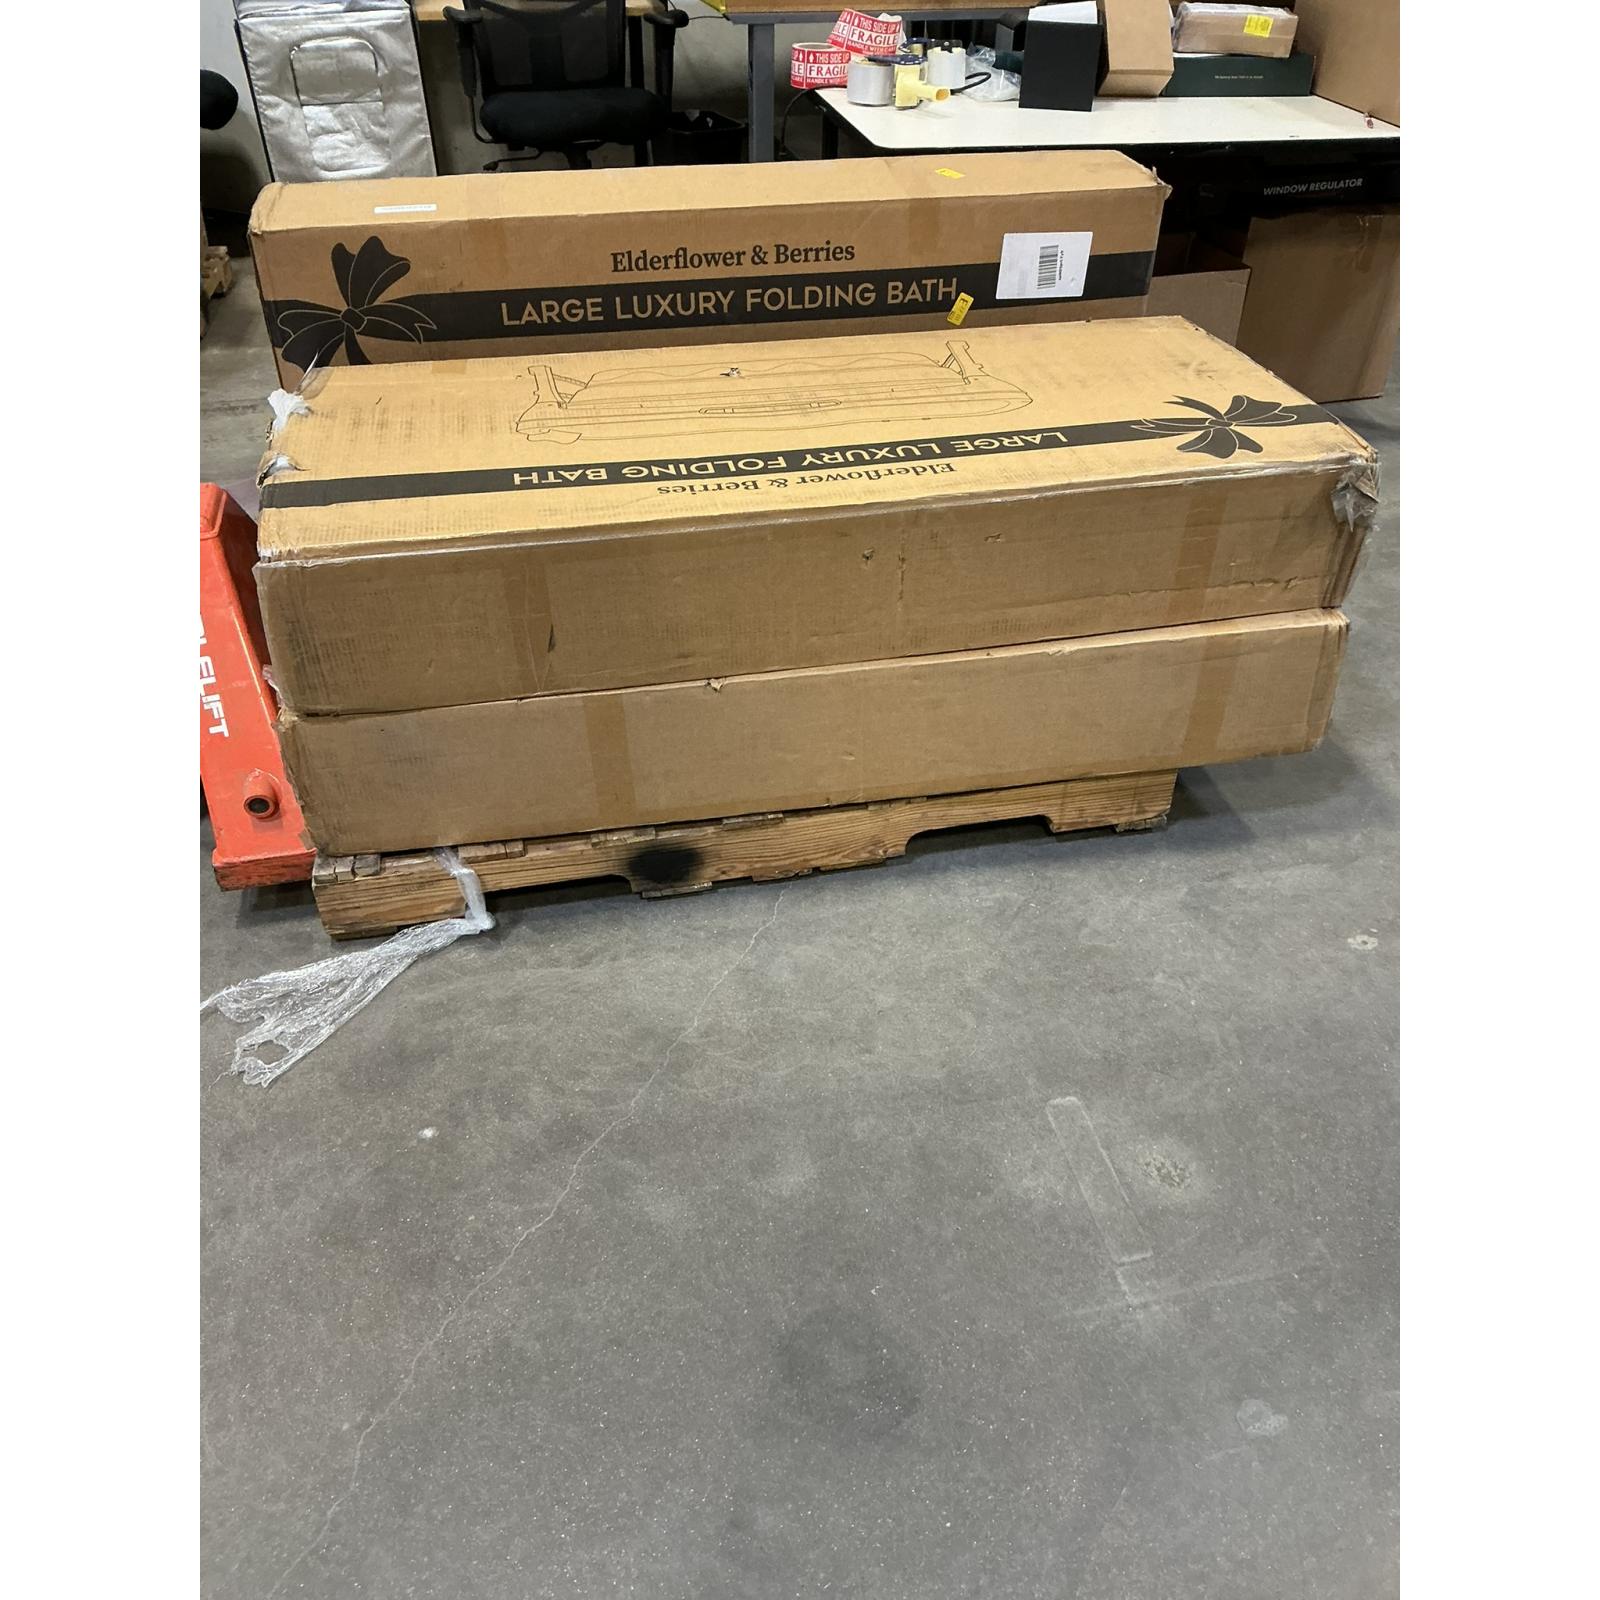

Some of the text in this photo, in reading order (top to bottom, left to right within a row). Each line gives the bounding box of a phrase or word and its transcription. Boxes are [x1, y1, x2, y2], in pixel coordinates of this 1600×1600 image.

[859, 17, 873, 32] THIS
[873, 20, 887, 34] SIDE
[850, 27, 897, 46] FRAGILE
[815, 53, 829, 62] THIS
[830, 53, 842, 62] SIDE
[808, 65, 848, 77] FRAGIL
[1264, 178, 1363, 195] WINDOW REGULATOR
[611, 240, 855, 273] Elderflower & Berries
[501, 277, 958, 326] LARGE LUXURY FOLDING BATH
[513, 431, 1068, 486] LARGE LUXURY FOLDING BATH
[657, 463, 957, 496] Elderflower & Berries
